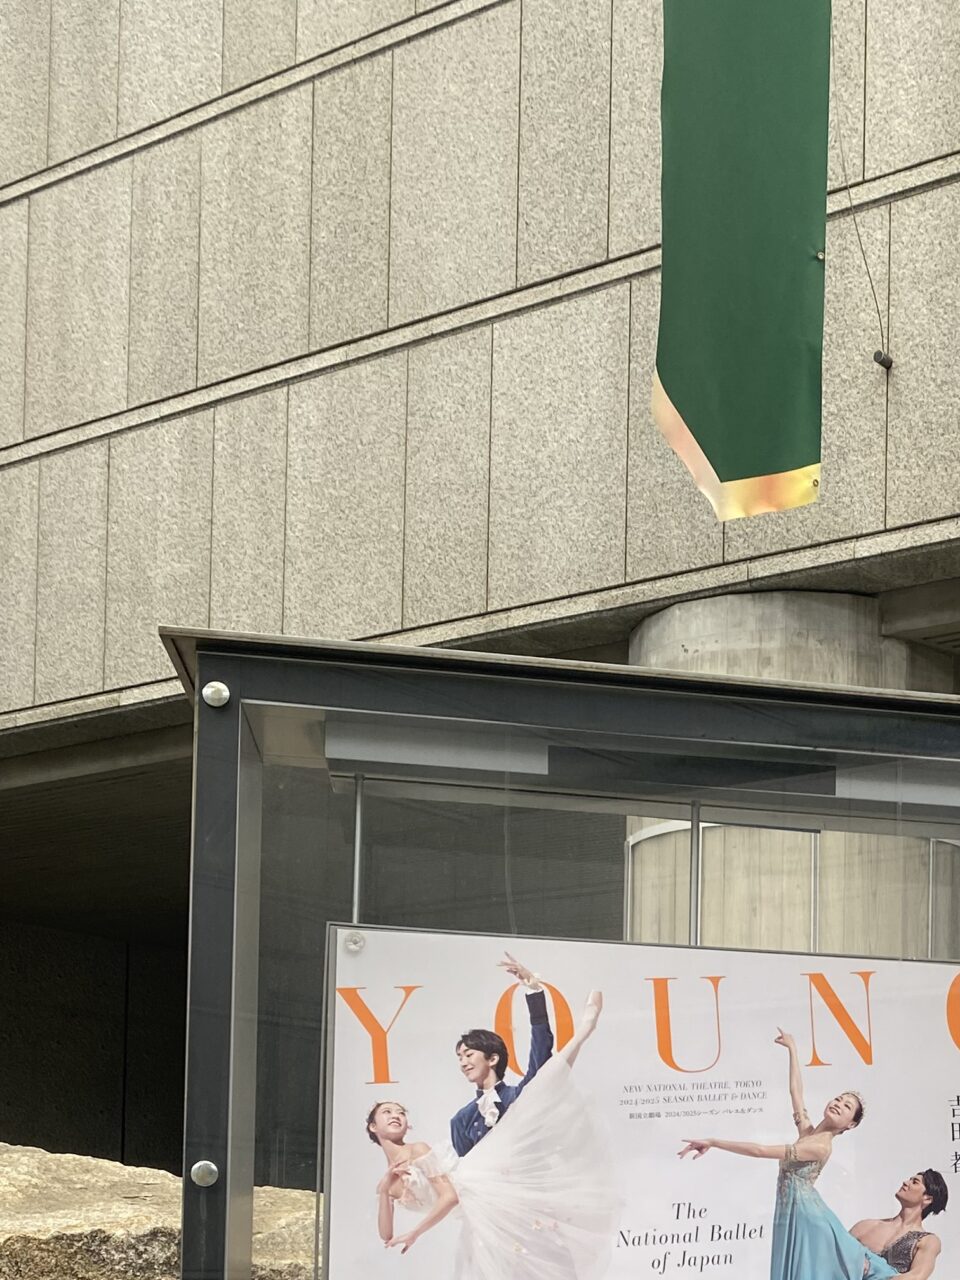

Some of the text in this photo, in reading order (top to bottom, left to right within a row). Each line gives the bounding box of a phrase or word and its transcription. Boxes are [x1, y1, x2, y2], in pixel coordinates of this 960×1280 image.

[623, 1084, 642, 1094] NEW
[646, 1083, 688, 1093] NATIONAL
[735, 1080, 762, 1089] TOKYO
[662, 1094, 695, 1104] SEASON
[697, 1093, 729, 1102] BALLET
[731, 1092, 739, 1100] &
[741, 1091, 768, 1100] DANCE
[672, 1202, 708, 1220] The
[616, 1223, 765, 1248] National Ballet
[651, 1250, 734, 1275] of Japan
